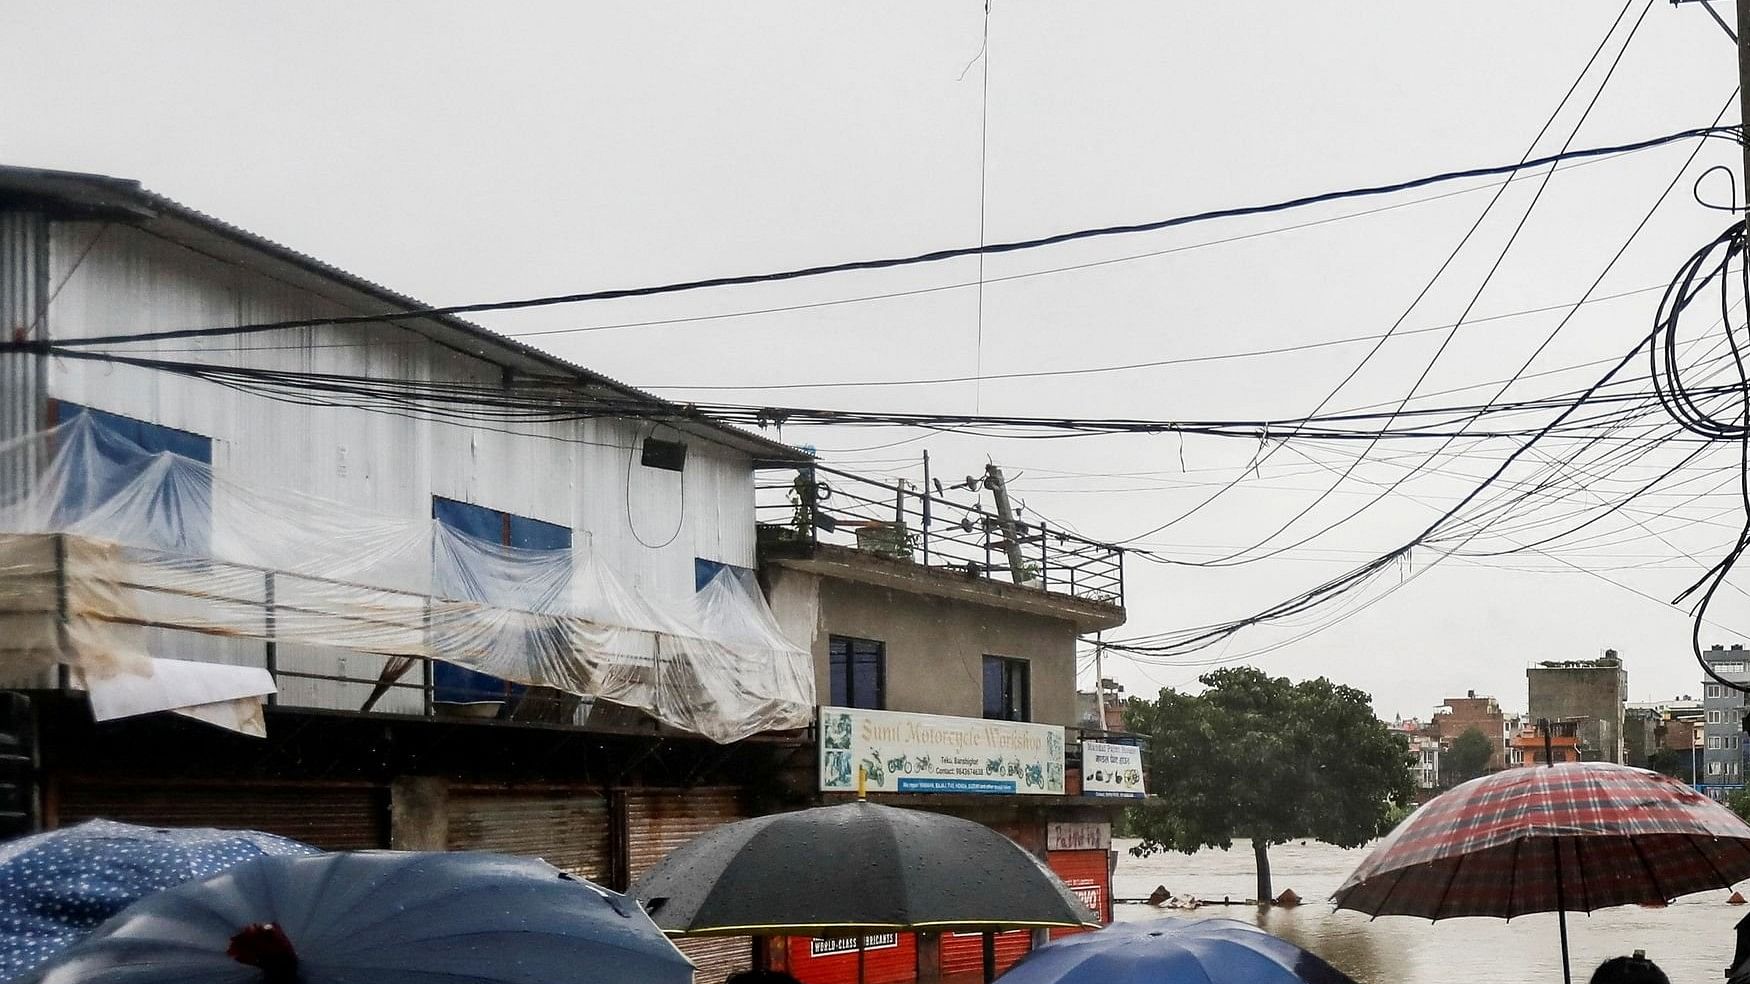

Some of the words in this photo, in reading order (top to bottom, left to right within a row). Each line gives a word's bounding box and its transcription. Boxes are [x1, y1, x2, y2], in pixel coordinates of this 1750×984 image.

[904, 720, 980, 752] Motorcycle
[982, 726, 1042, 754] Workshop
[814, 937, 857, 953] WORLD-CLASS
[863, 933, 893, 947] BRICANTS
